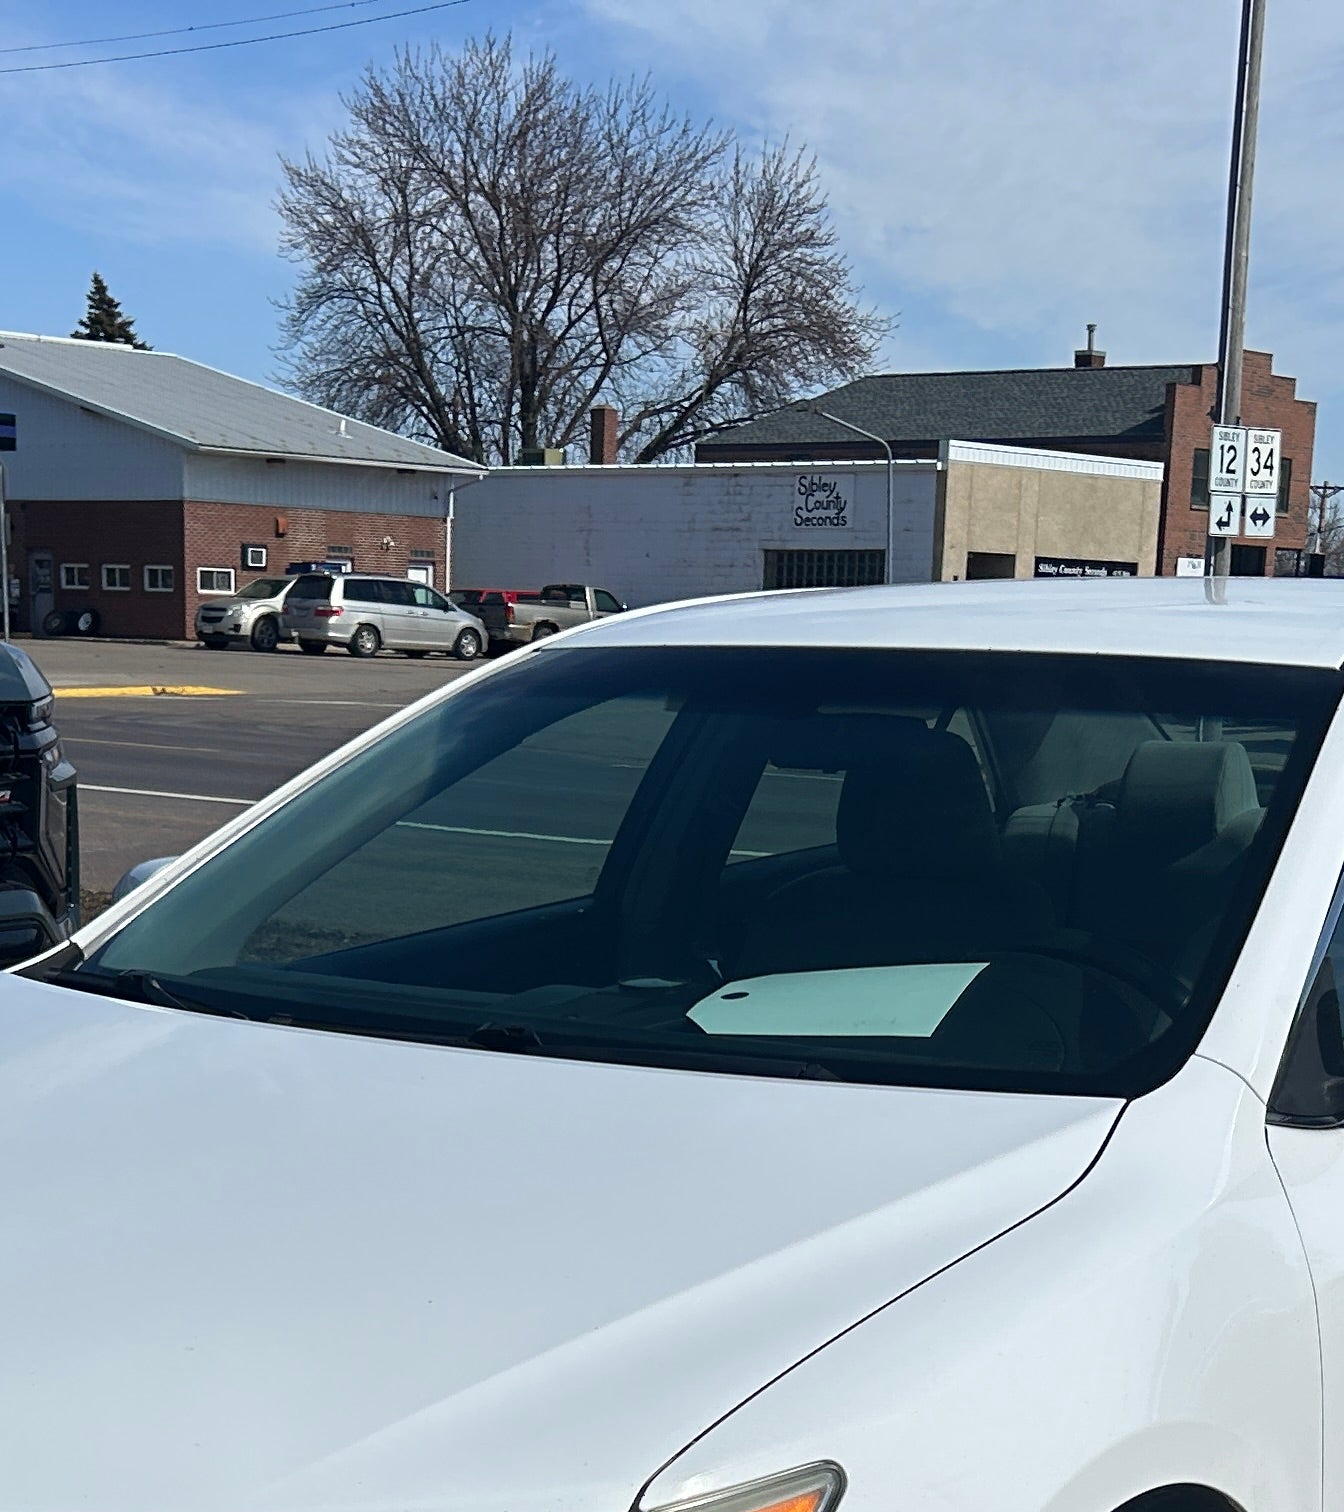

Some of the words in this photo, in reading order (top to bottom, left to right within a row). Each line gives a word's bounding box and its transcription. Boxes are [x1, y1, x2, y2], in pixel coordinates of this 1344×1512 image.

[1218, 430, 1241, 443] SIBLEY
[1253, 434, 1275, 445] SIBLEY
[1219, 444, 1238, 475] 12
[1250, 446, 1275, 477] 34
[797, 475, 837, 498] Sibley
[1214, 477, 1239, 488] COUNTY
[1249, 480, 1274, 491] COUNTY
[805, 492, 847, 515] County
[794, 506, 847, 527] Seconds
